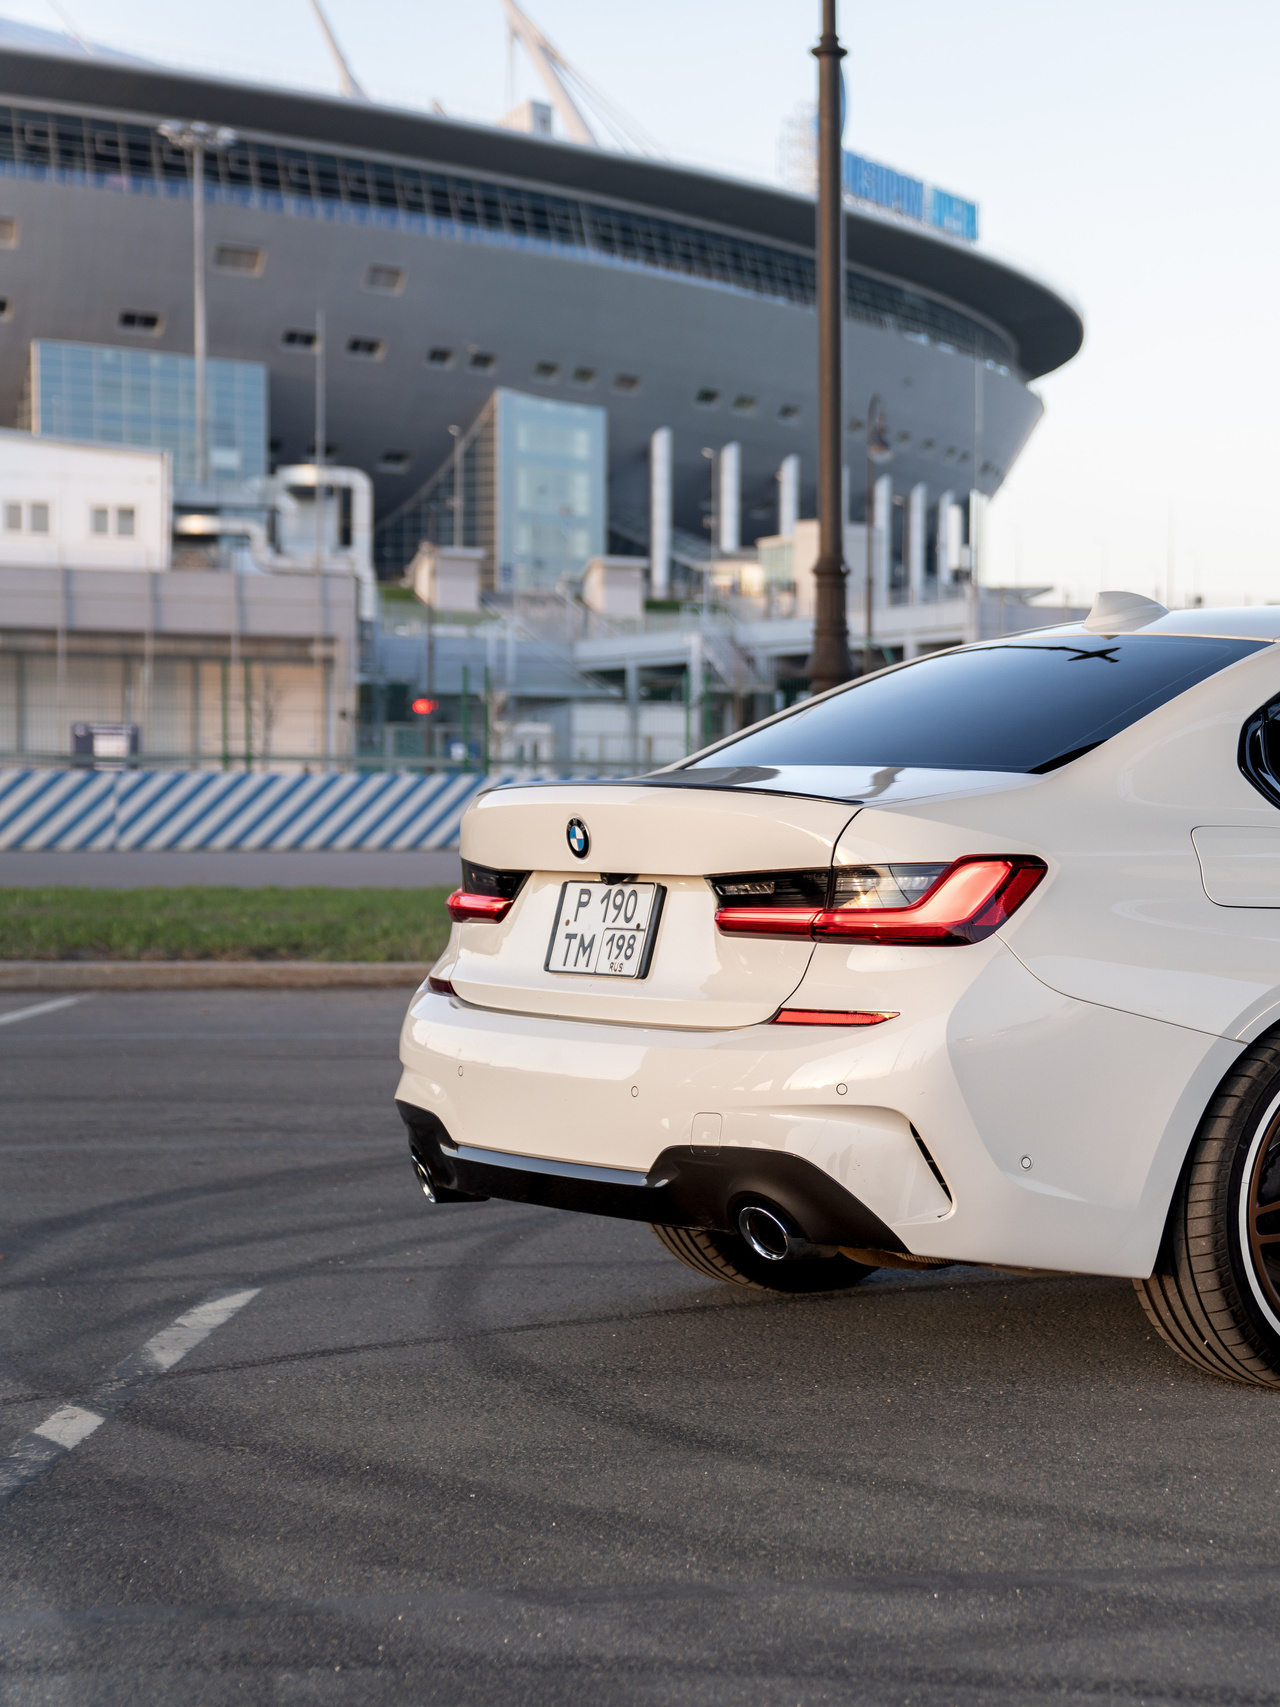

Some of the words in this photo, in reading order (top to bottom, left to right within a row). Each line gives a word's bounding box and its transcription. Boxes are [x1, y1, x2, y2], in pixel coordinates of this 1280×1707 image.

[574, 888, 591, 922] P
[600, 888, 638, 923] 190
[563, 933, 596, 967] TM
[605, 934, 636, 960] 198
[608, 962, 624, 973] RUS
